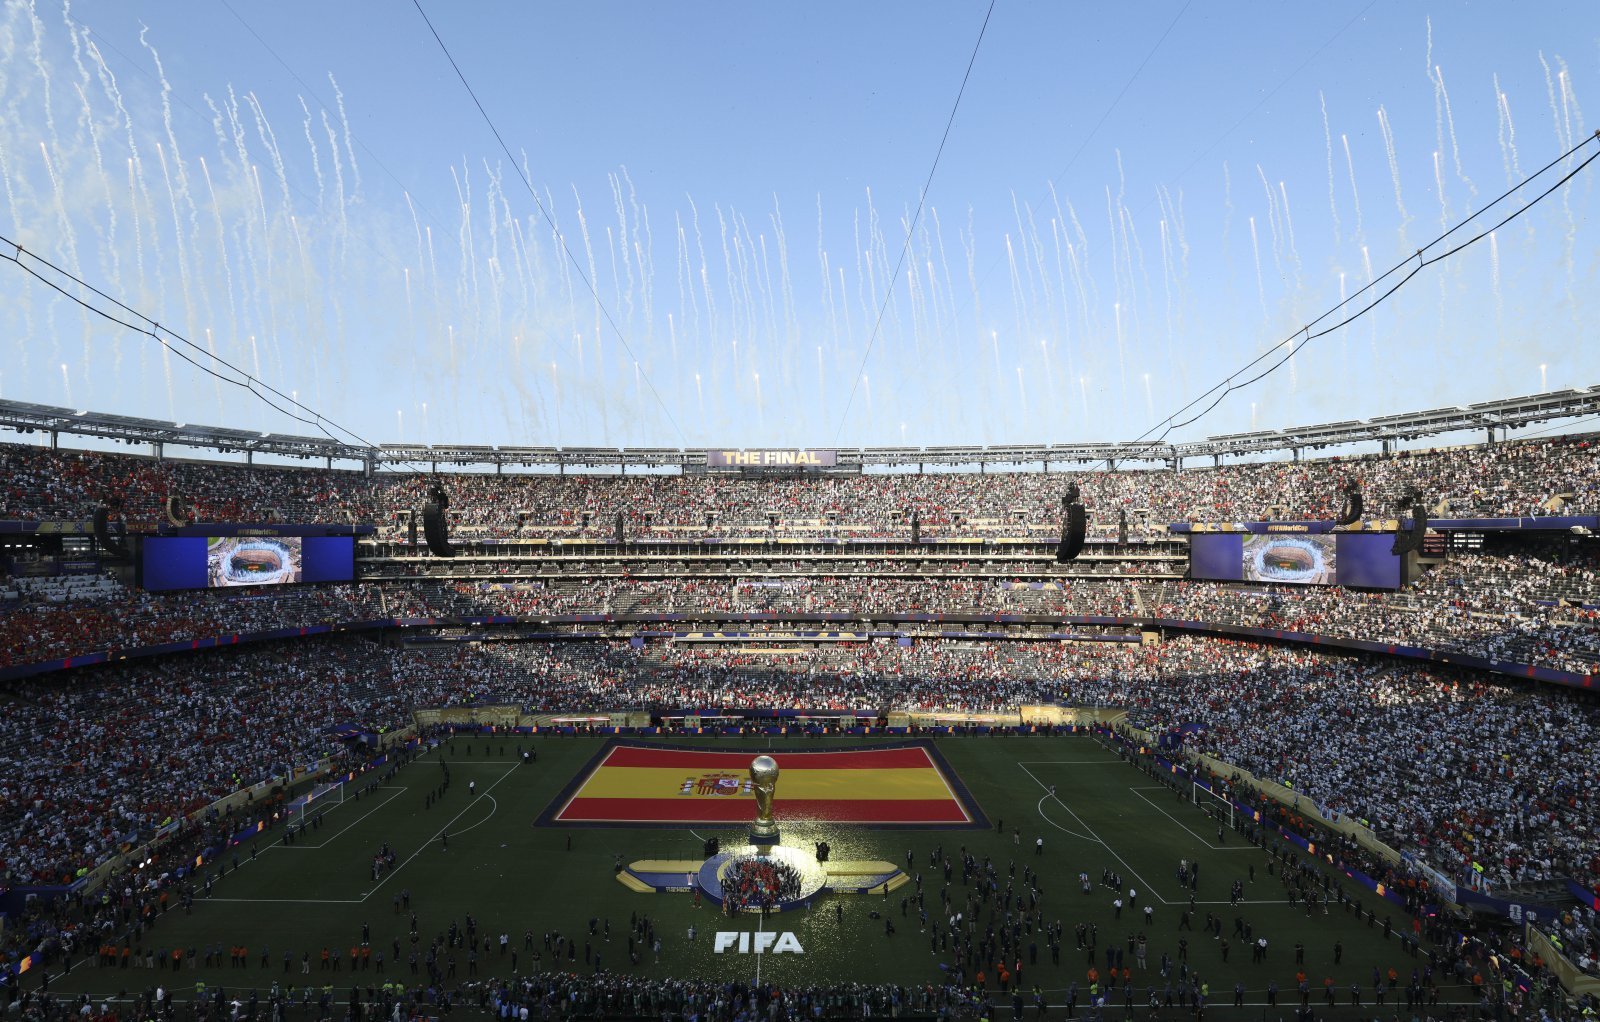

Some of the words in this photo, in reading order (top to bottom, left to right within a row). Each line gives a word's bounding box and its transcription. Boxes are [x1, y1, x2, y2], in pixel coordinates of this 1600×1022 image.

[722, 451, 761, 465] THE
[764, 451, 821, 465] FINAL
[714, 932, 804, 953] FIFA
